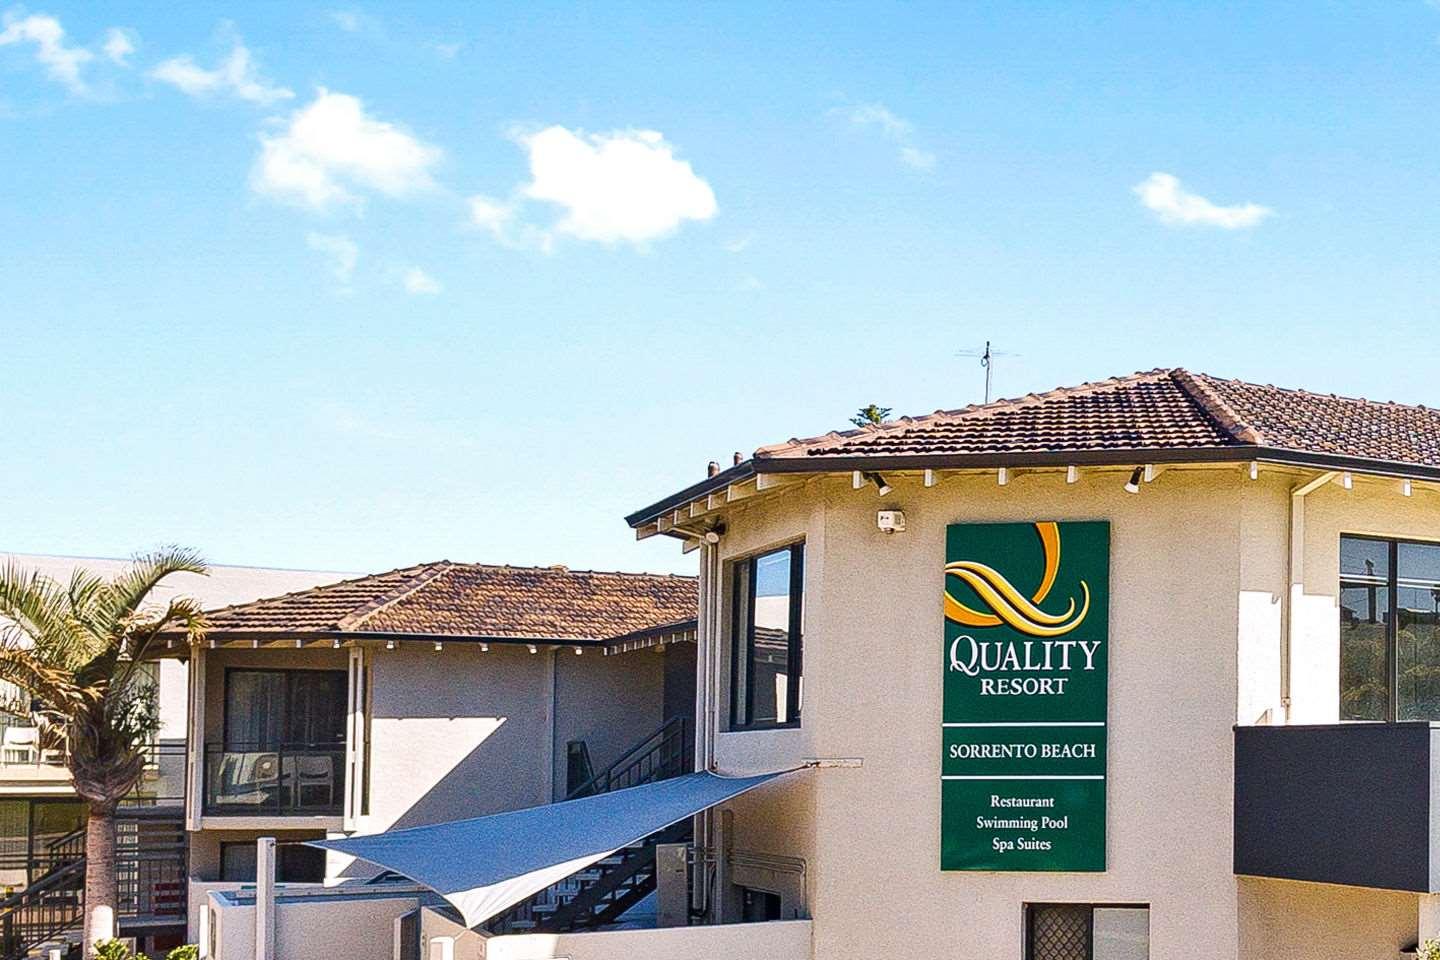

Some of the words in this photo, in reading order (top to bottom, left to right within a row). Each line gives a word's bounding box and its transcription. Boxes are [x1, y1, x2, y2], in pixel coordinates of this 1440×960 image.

[950, 635, 1102, 676] QUALITY
[980, 678, 1069, 695] RESORT
[950, 744, 1037, 759] SORRENTO
[1041, 743, 1096, 758] BEACH
[991, 794, 1055, 808] Restaurant
[976, 815, 1039, 832] Swimming
[1041, 815, 1069, 829] Pool
[992, 837, 1014, 853] Spa
[1017, 837, 1052, 850] Suites
